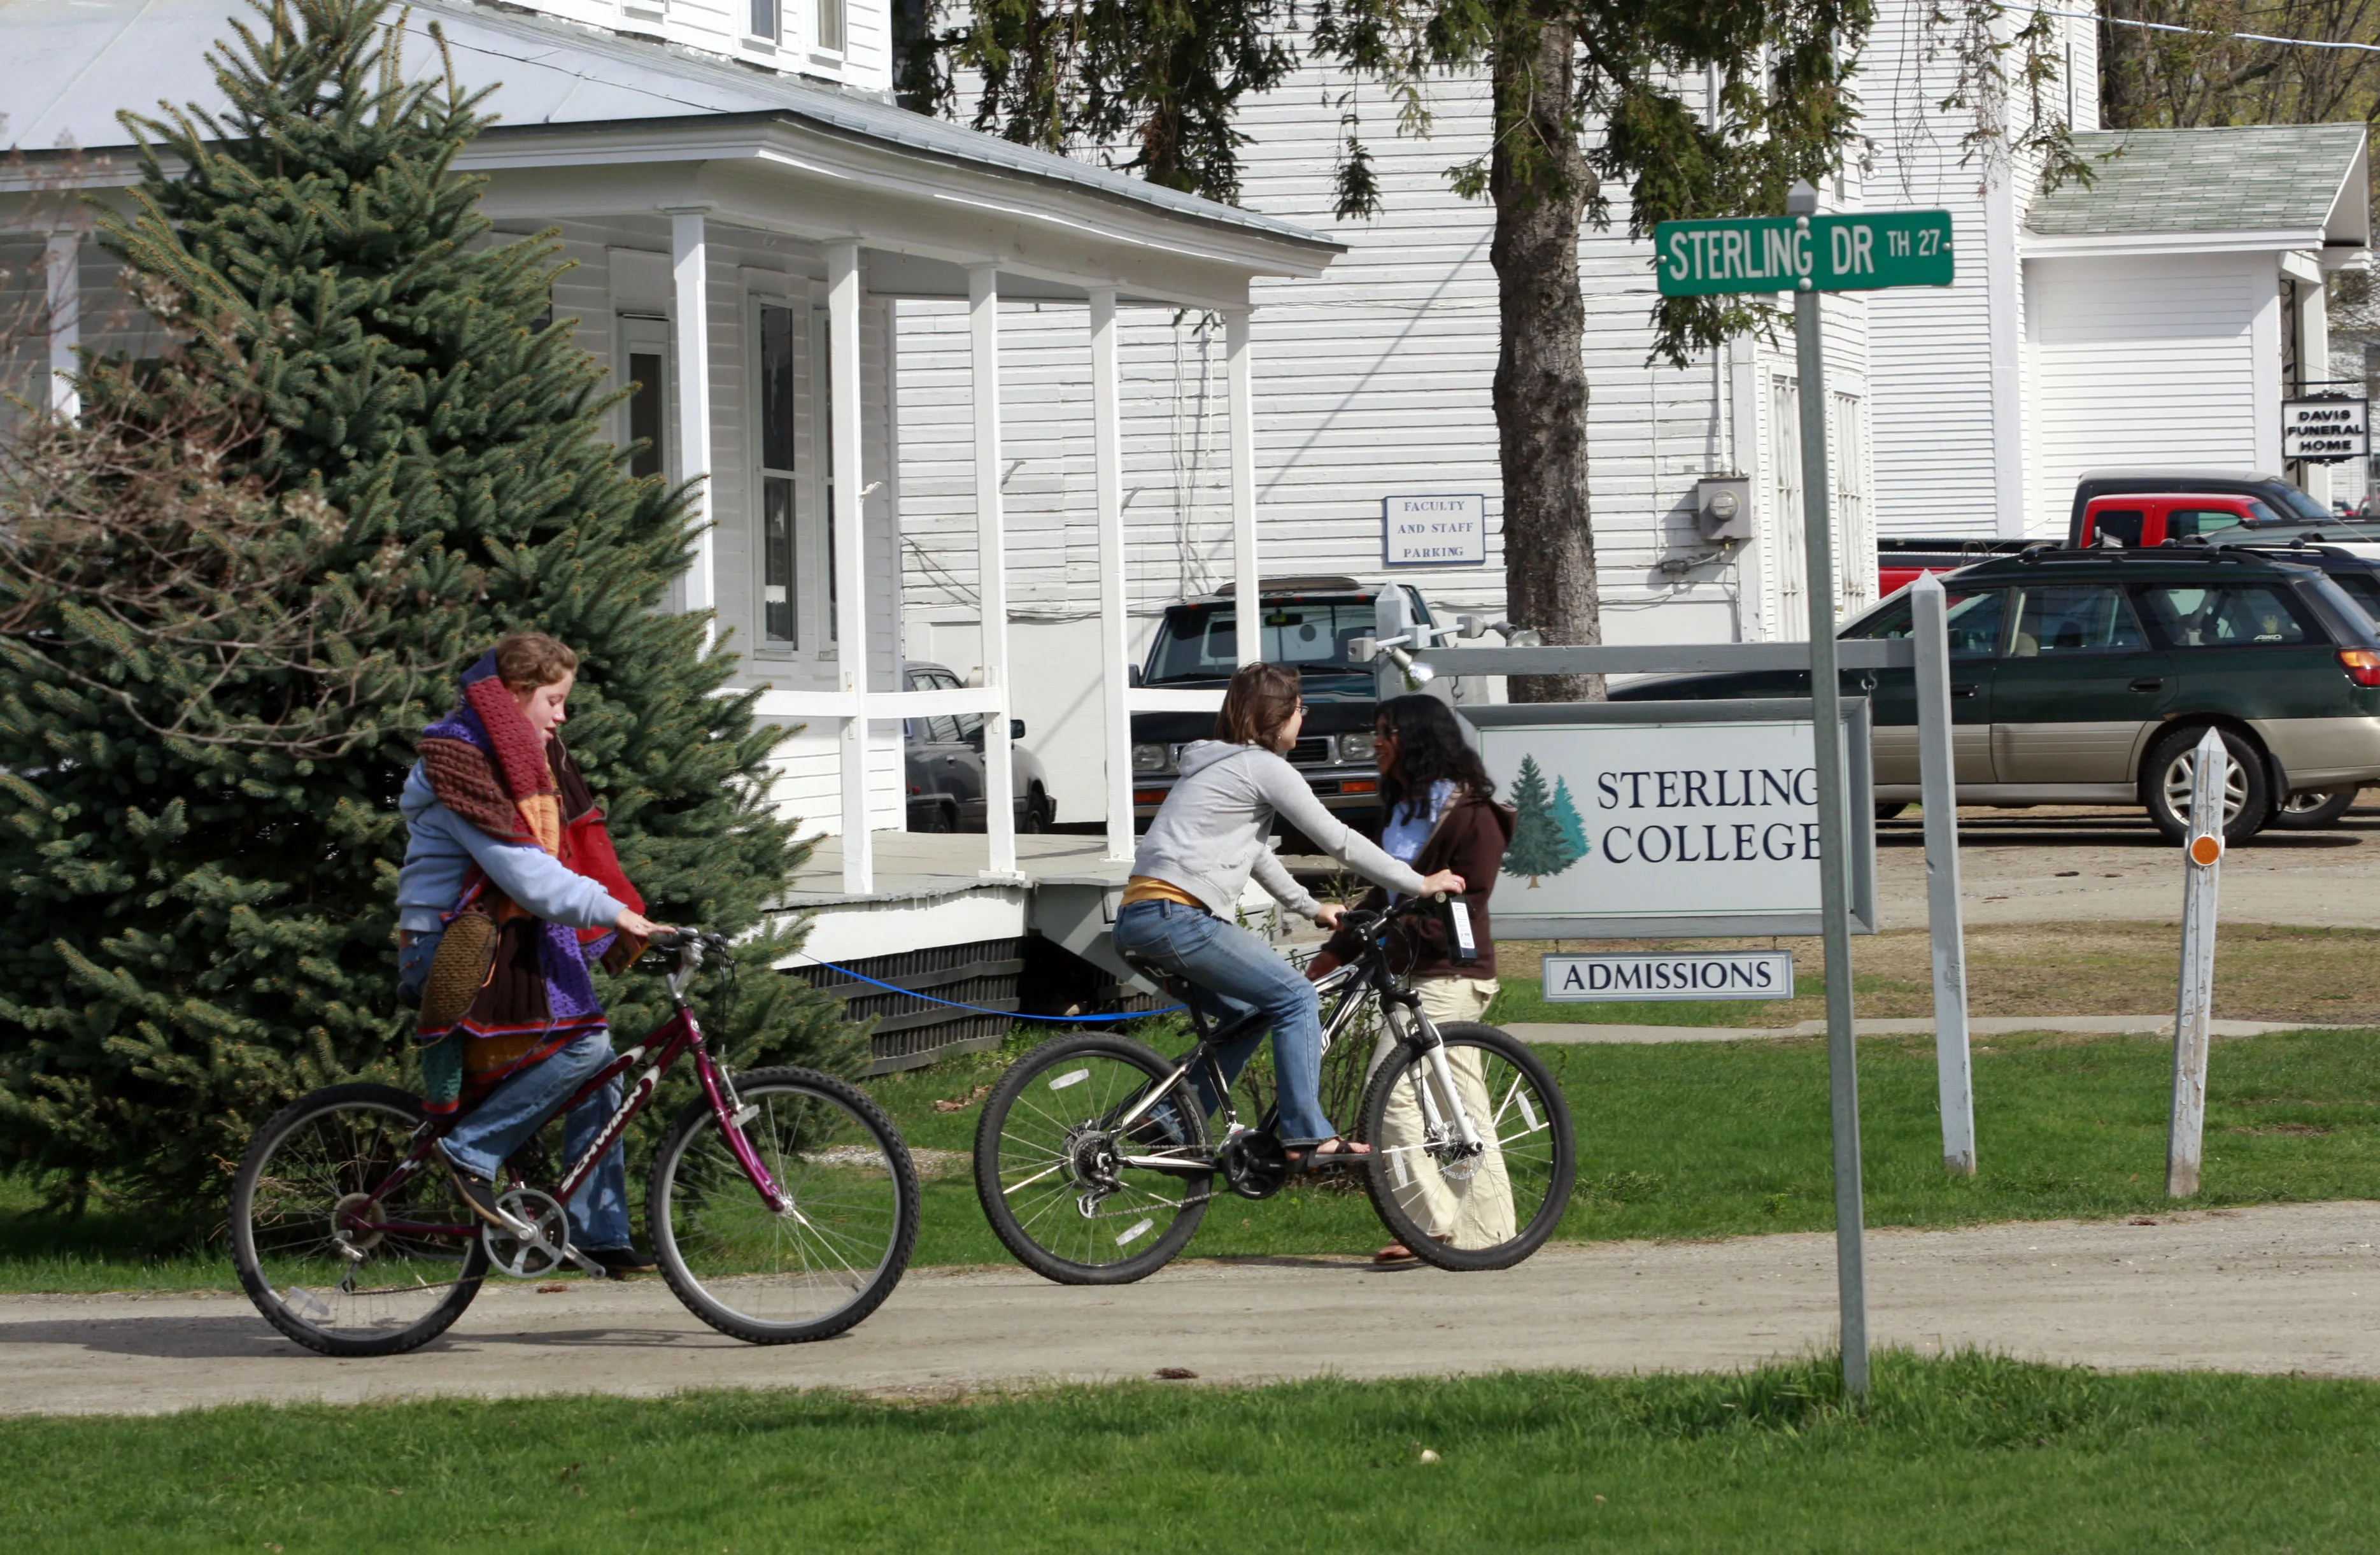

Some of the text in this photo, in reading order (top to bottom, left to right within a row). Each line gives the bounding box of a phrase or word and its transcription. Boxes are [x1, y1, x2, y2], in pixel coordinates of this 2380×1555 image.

[1669, 225, 1941, 280] STERLING DR TH 27
[2299, 410, 2351, 421] DAVIS
[2288, 425, 2364, 436] FUNERAL
[2301, 441, 2352, 450] HOME
[1404, 501, 1464, 511] FACULTY
[1398, 522, 1473, 534] AND STAFF
[1403, 546, 1463, 558] PARKING
[1597, 767, 1818, 810] STERLING
[1603, 823, 1821, 863] COLLEGE
[1563, 961, 1771, 990] ADMISSIONS
[560, 1084, 642, 1193] SCHWINN
